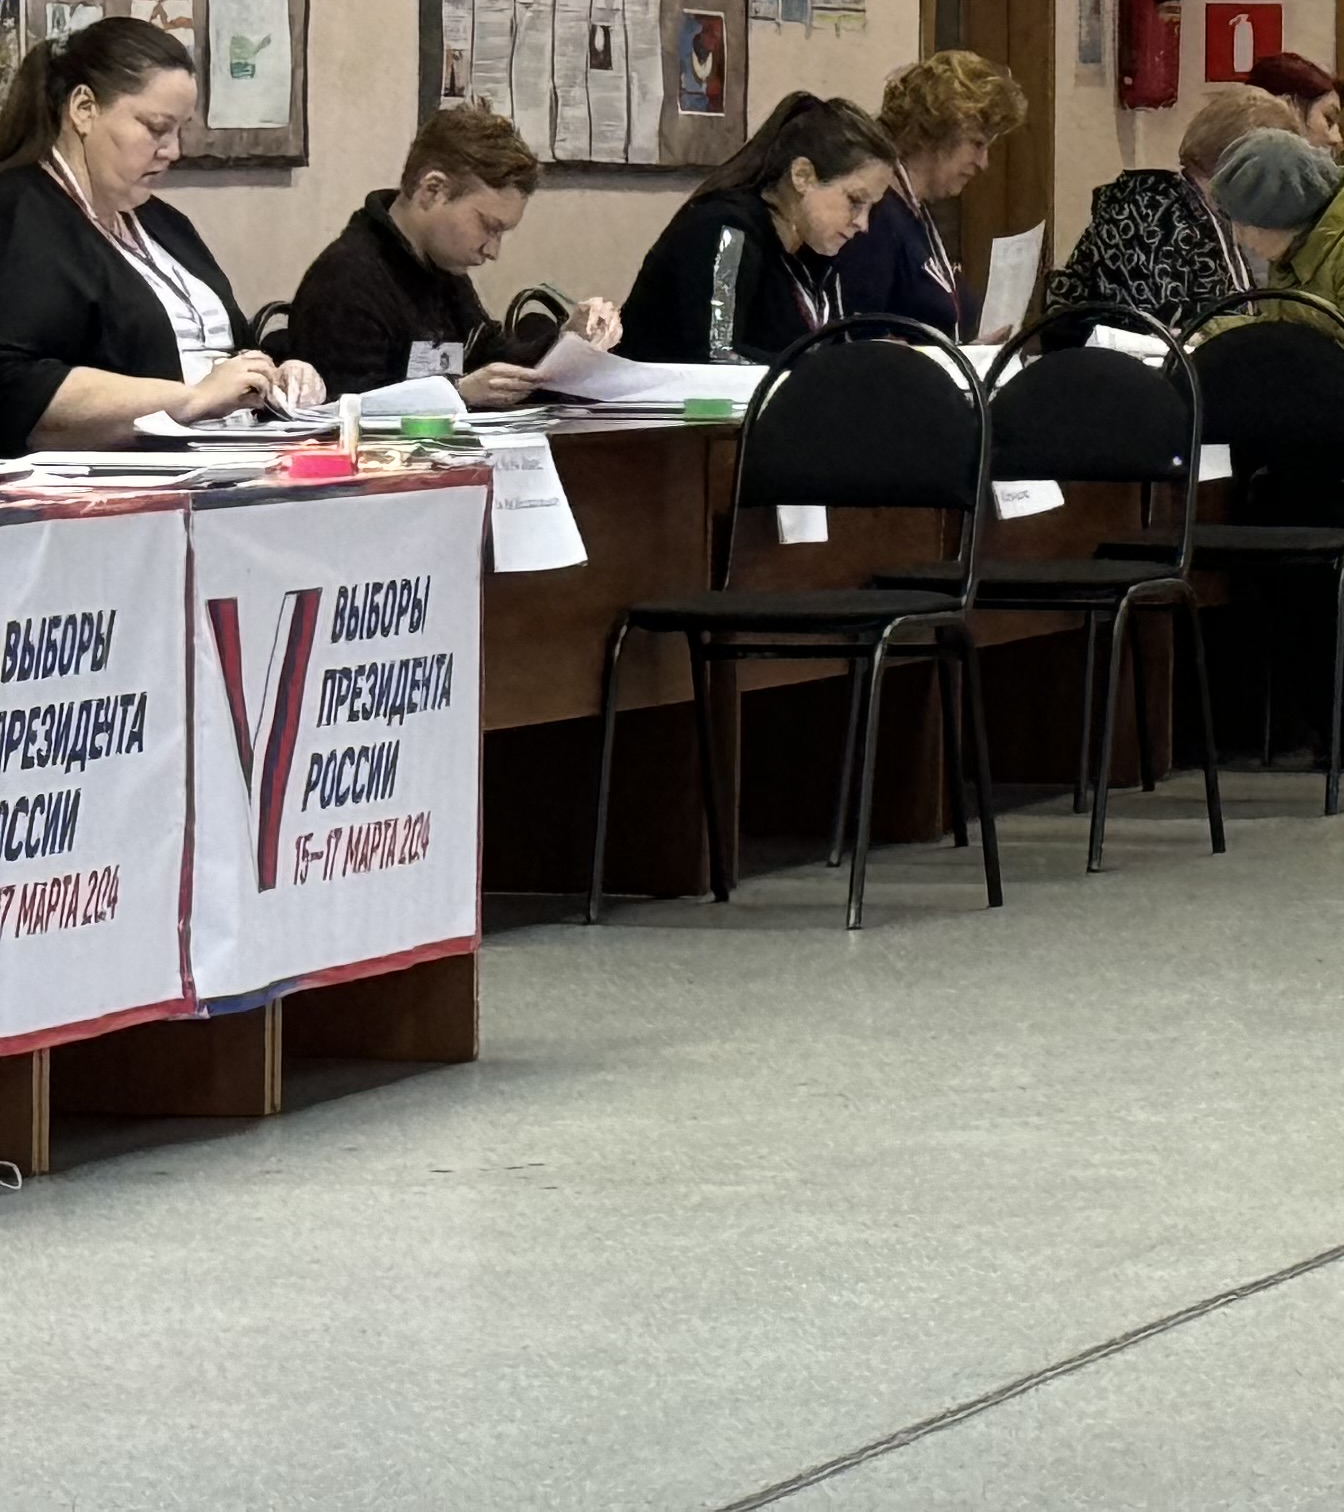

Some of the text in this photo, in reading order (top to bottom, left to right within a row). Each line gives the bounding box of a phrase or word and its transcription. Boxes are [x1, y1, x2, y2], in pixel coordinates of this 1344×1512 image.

[331, 574, 431, 644] ВЫБОРЫ
[0, 609, 117, 684] ВЫБОРЫ
[316, 652, 453, 728] ПРЕЗИДЕНТА
[301, 739, 400, 813] РОССИИ
[342, 818, 399, 878] МАРТА
[15, 872, 81, 938] МАРТА
